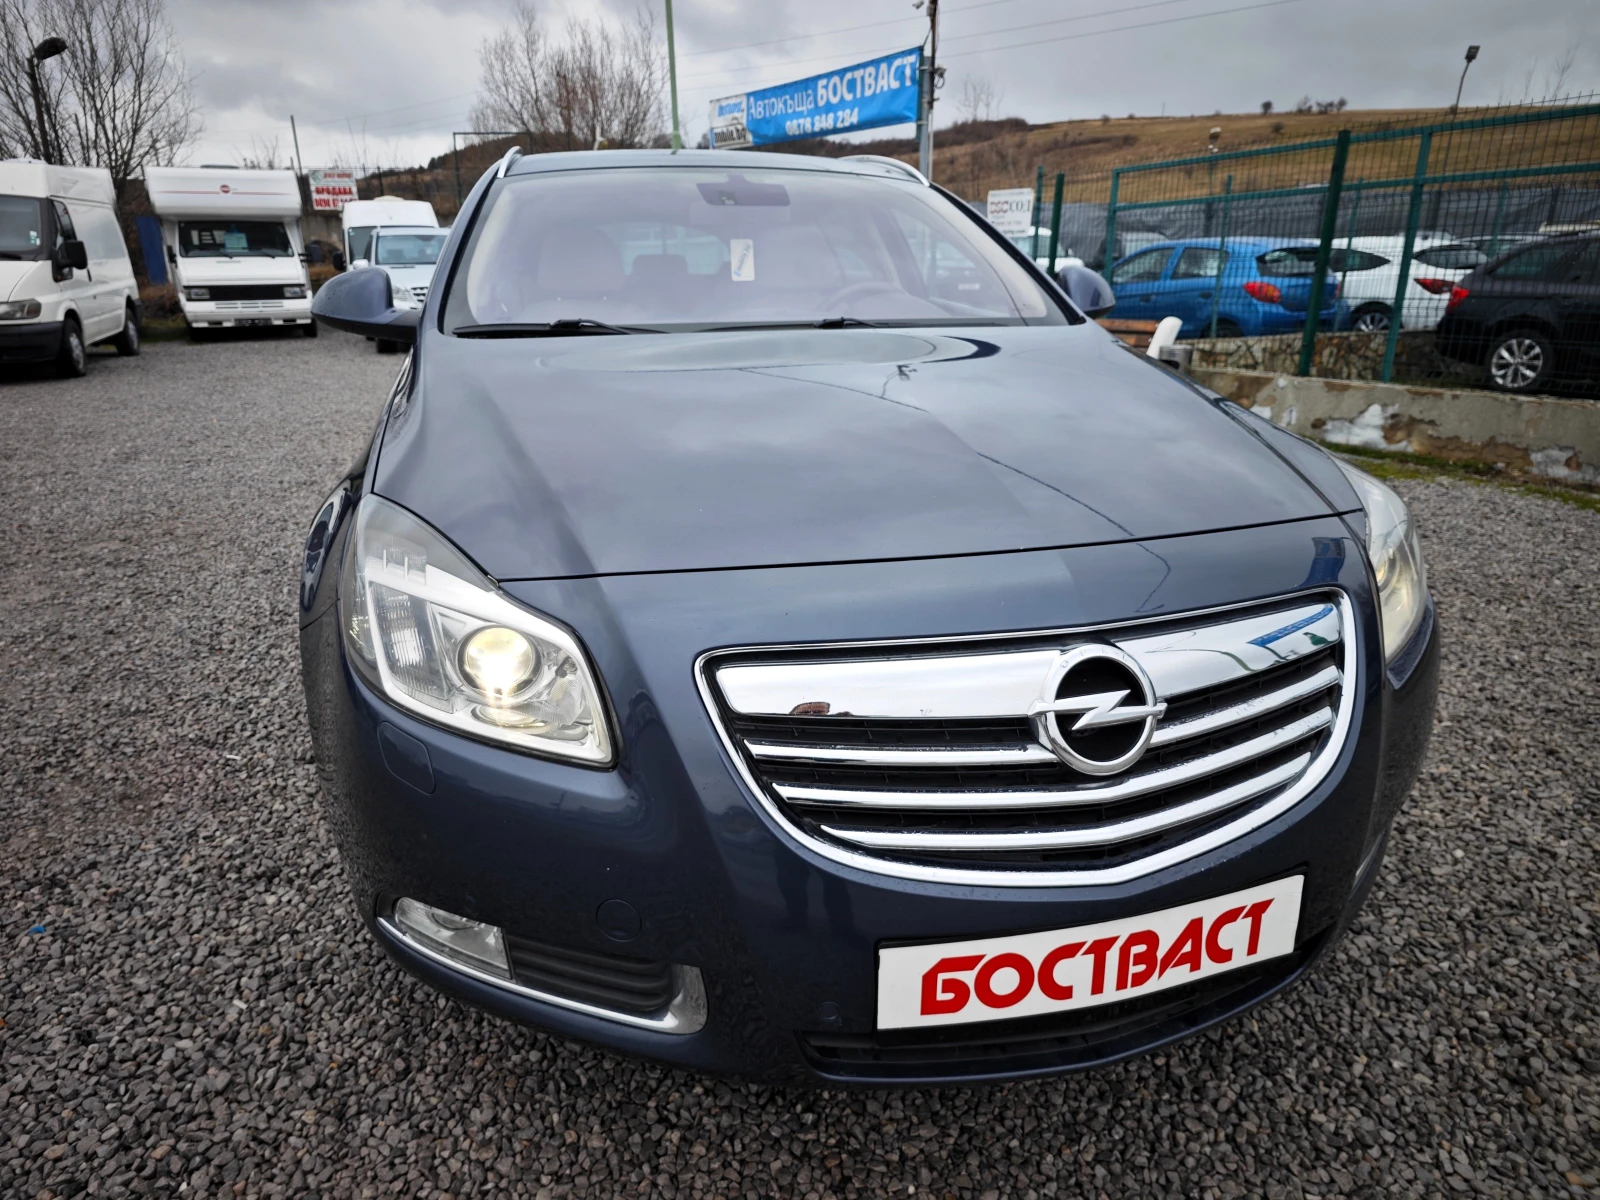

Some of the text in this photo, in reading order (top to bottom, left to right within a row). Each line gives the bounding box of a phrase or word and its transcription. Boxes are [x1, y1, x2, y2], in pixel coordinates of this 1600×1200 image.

[749, 54, 917, 120] Автокъща БОСТВАСТ
[1060, 642, 1128, 668] OPEL
[920, 898, 1276, 1016] БОСТВАСТ
